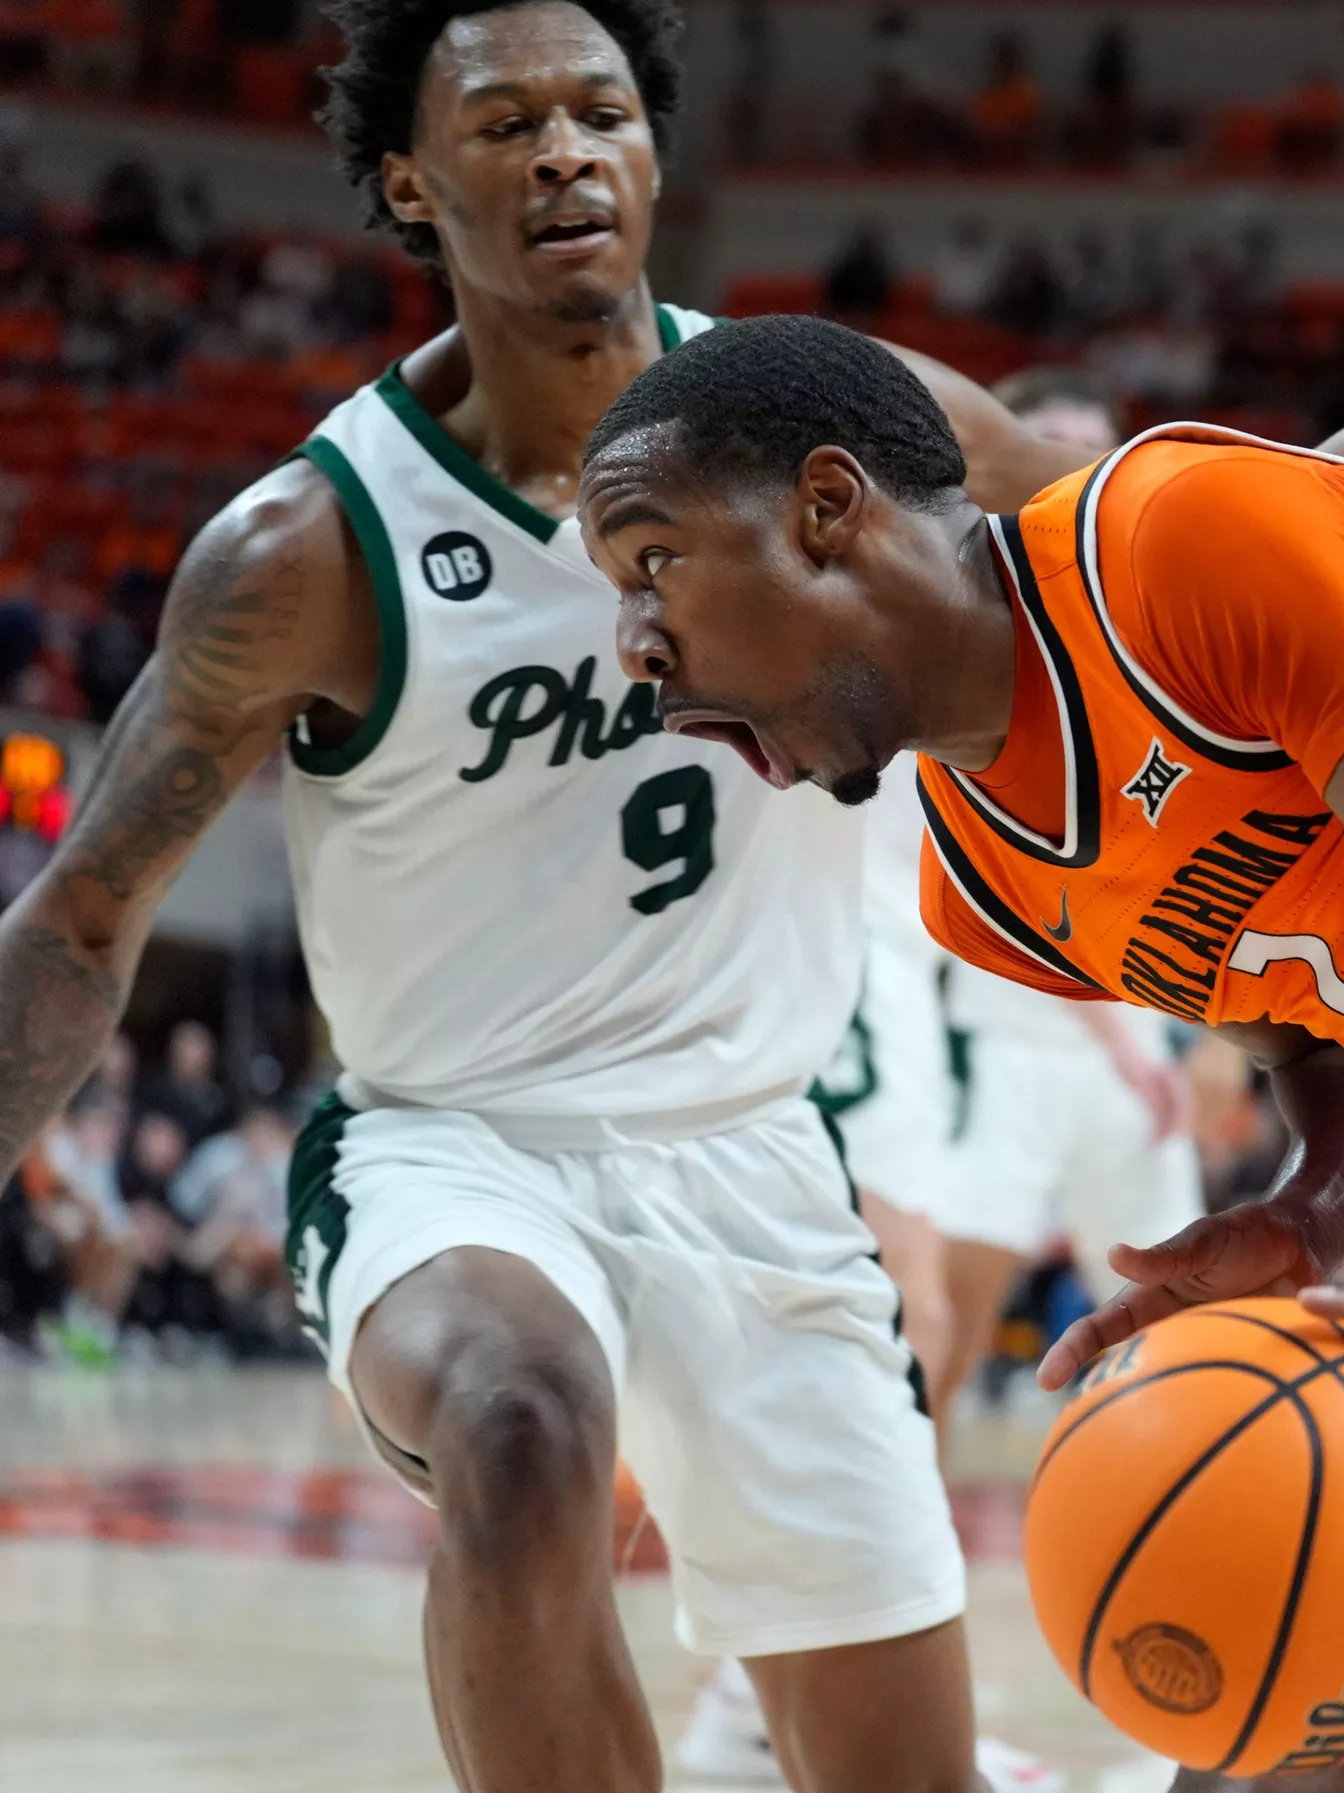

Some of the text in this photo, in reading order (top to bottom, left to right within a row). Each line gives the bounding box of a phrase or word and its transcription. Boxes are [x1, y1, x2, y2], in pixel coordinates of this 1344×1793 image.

[425, 545, 484, 590] DB
[1125, 742, 1185, 819] XII
[620, 764, 716, 916] 9
[1121, 810, 1334, 1023] OKLAHOMA
